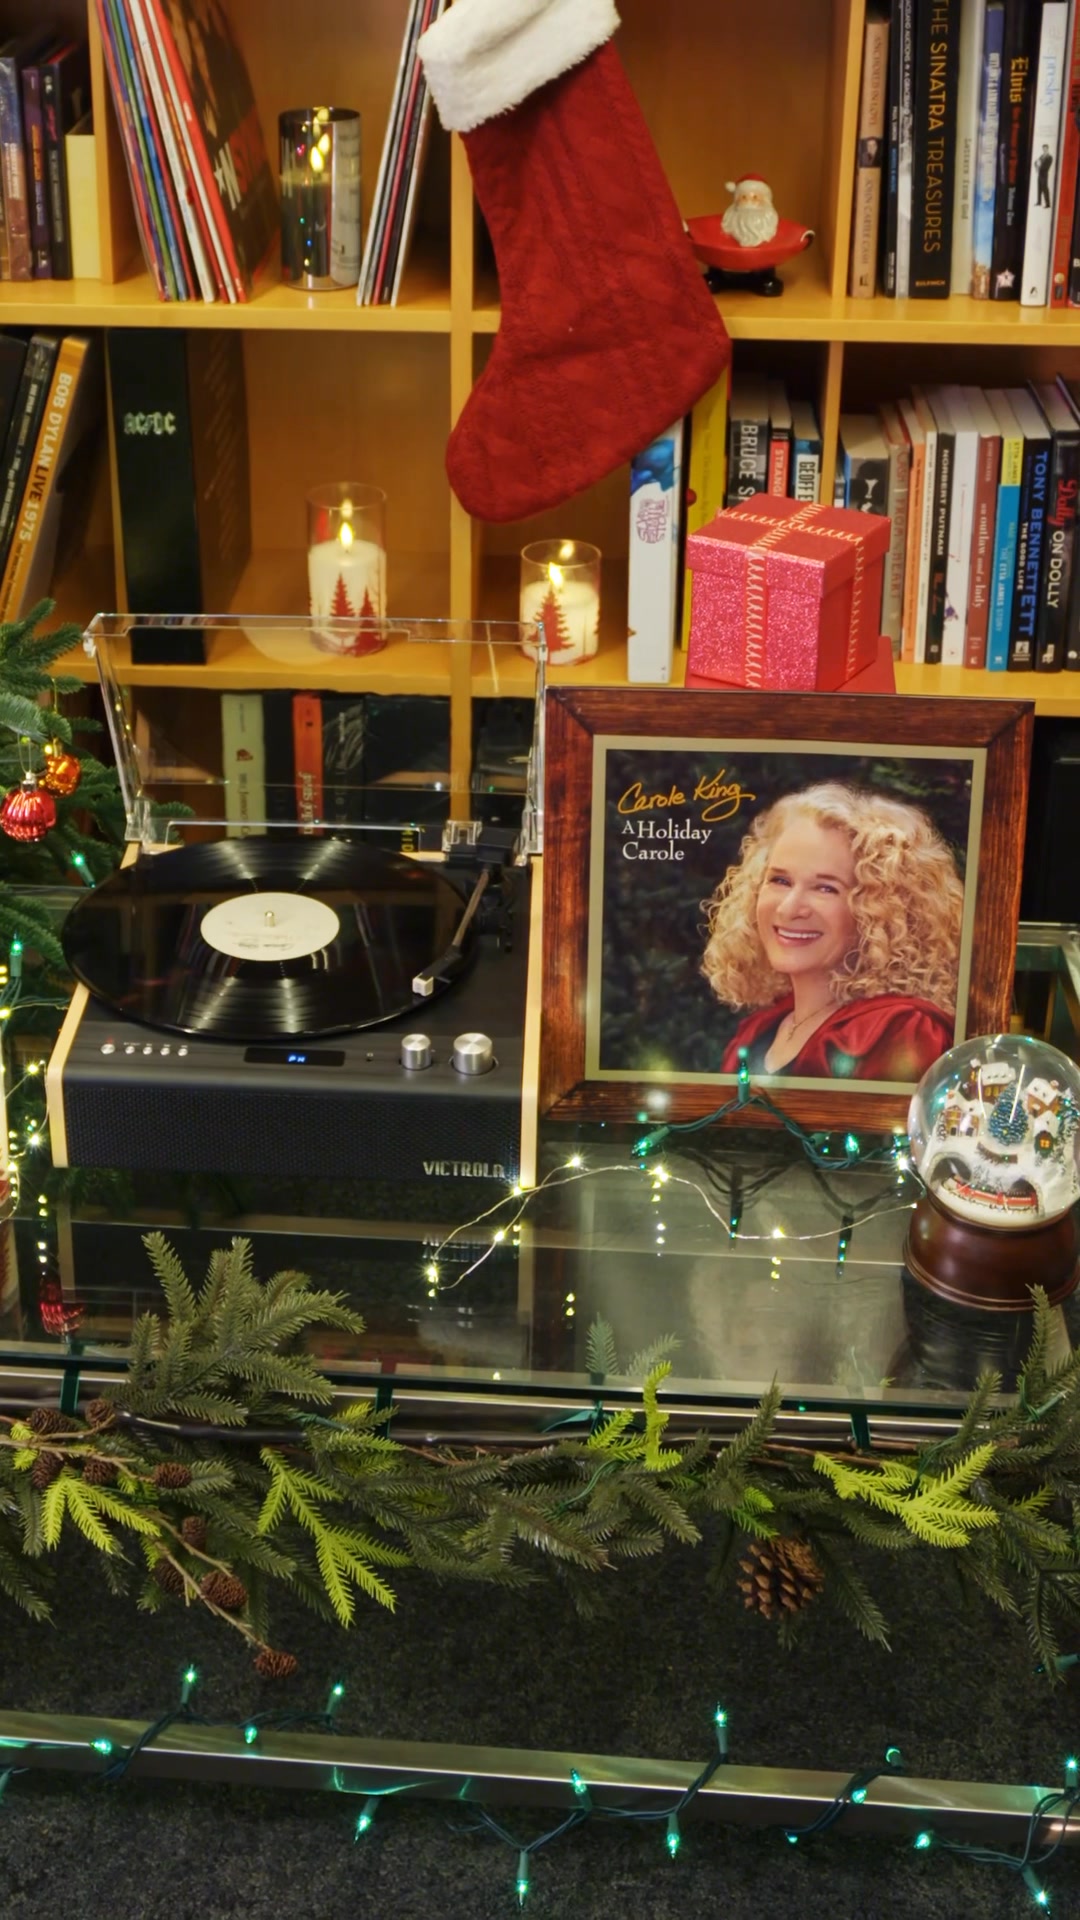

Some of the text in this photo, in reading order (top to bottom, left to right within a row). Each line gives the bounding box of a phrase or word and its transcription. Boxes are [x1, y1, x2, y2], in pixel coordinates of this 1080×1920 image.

[1009, 56, 1029, 103] Elvis
[924, 0, 949, 253] THE SINATRA TREASURES
[123, 411, 176, 436] AC/DC
[19, 372, 72, 541] BOB DYLAN LIVE 1975
[739, 424, 758, 480] BRUCE
[798, 461, 816, 492] GEOFF
[1032, 451, 1049, 501] TONY
[937, 448, 950, 555] NORBERT PUTNAM
[978, 515, 990, 555] outlaw
[1021, 522, 1029, 540] THE
[1047, 478, 1077, 609] Dolly ON DOLLY
[1019, 542, 1027, 568] GOOD
[998, 562, 1008, 580] ETTA
[1016, 569, 1024, 590] LIFE
[972, 584, 987, 609] lady
[996, 582, 1006, 606] JAMES
[617, 768, 757, 822] Carole King
[621, 818, 713, 844] A Holiday
[622, 839, 686, 861] Carole
[422, 1160, 505, 1179] VICTROLA
